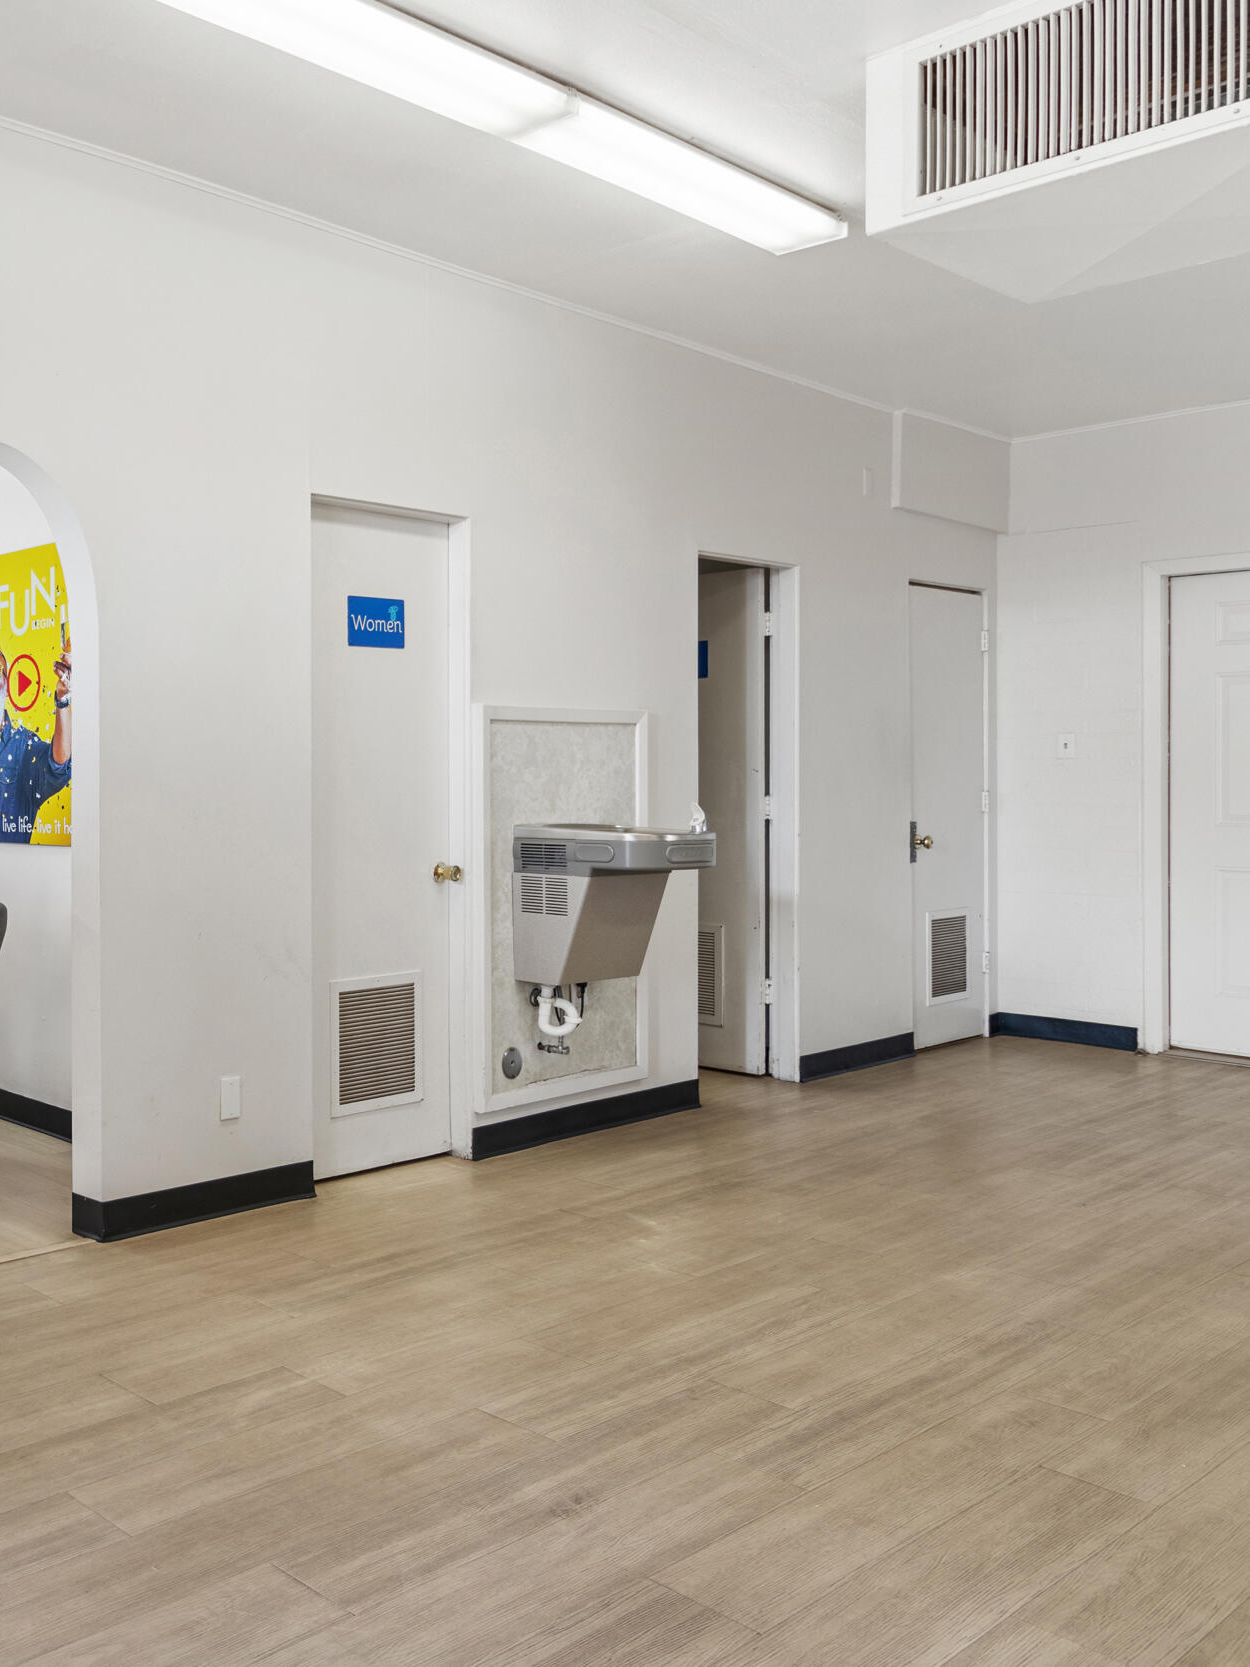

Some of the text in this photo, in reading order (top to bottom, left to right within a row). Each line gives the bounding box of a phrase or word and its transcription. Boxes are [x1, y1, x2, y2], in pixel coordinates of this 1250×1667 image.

[31, 617, 55, 631] BEGIN
[350, 613, 403, 633] Women
[2, 815, 17, 833] live
[36, 816, 52, 834] live
[54, 819, 62, 834] it
